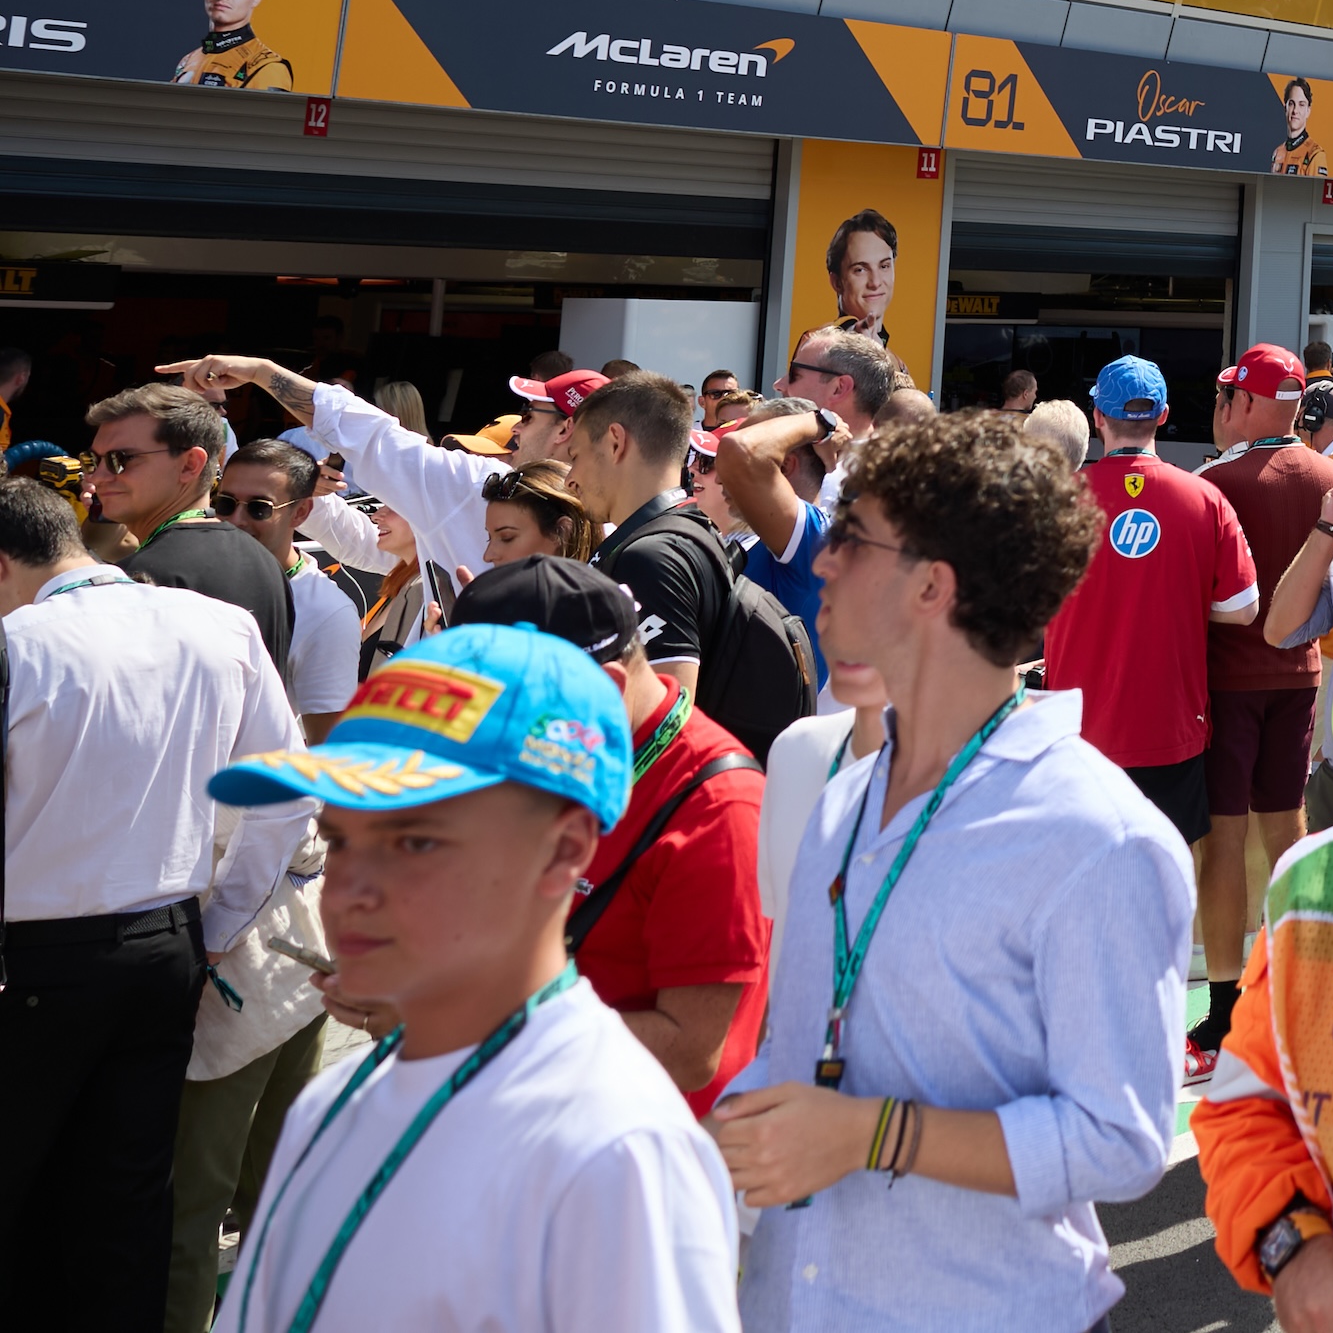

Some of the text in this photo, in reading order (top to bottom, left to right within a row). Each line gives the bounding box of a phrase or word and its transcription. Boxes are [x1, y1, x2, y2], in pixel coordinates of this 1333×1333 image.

[0, 14, 88, 53] IS
[546, 31, 768, 77] McLaren
[594, 79, 764, 108] FORMULA 1 TEAM
[960, 69, 1025, 131] 81
[1136, 69, 1206, 122] Oscar
[307, 103, 327, 129] 12
[1085, 117, 1242, 154] PIASTRI
[920, 151, 937, 173] 11
[1116, 511, 1155, 556] hp
